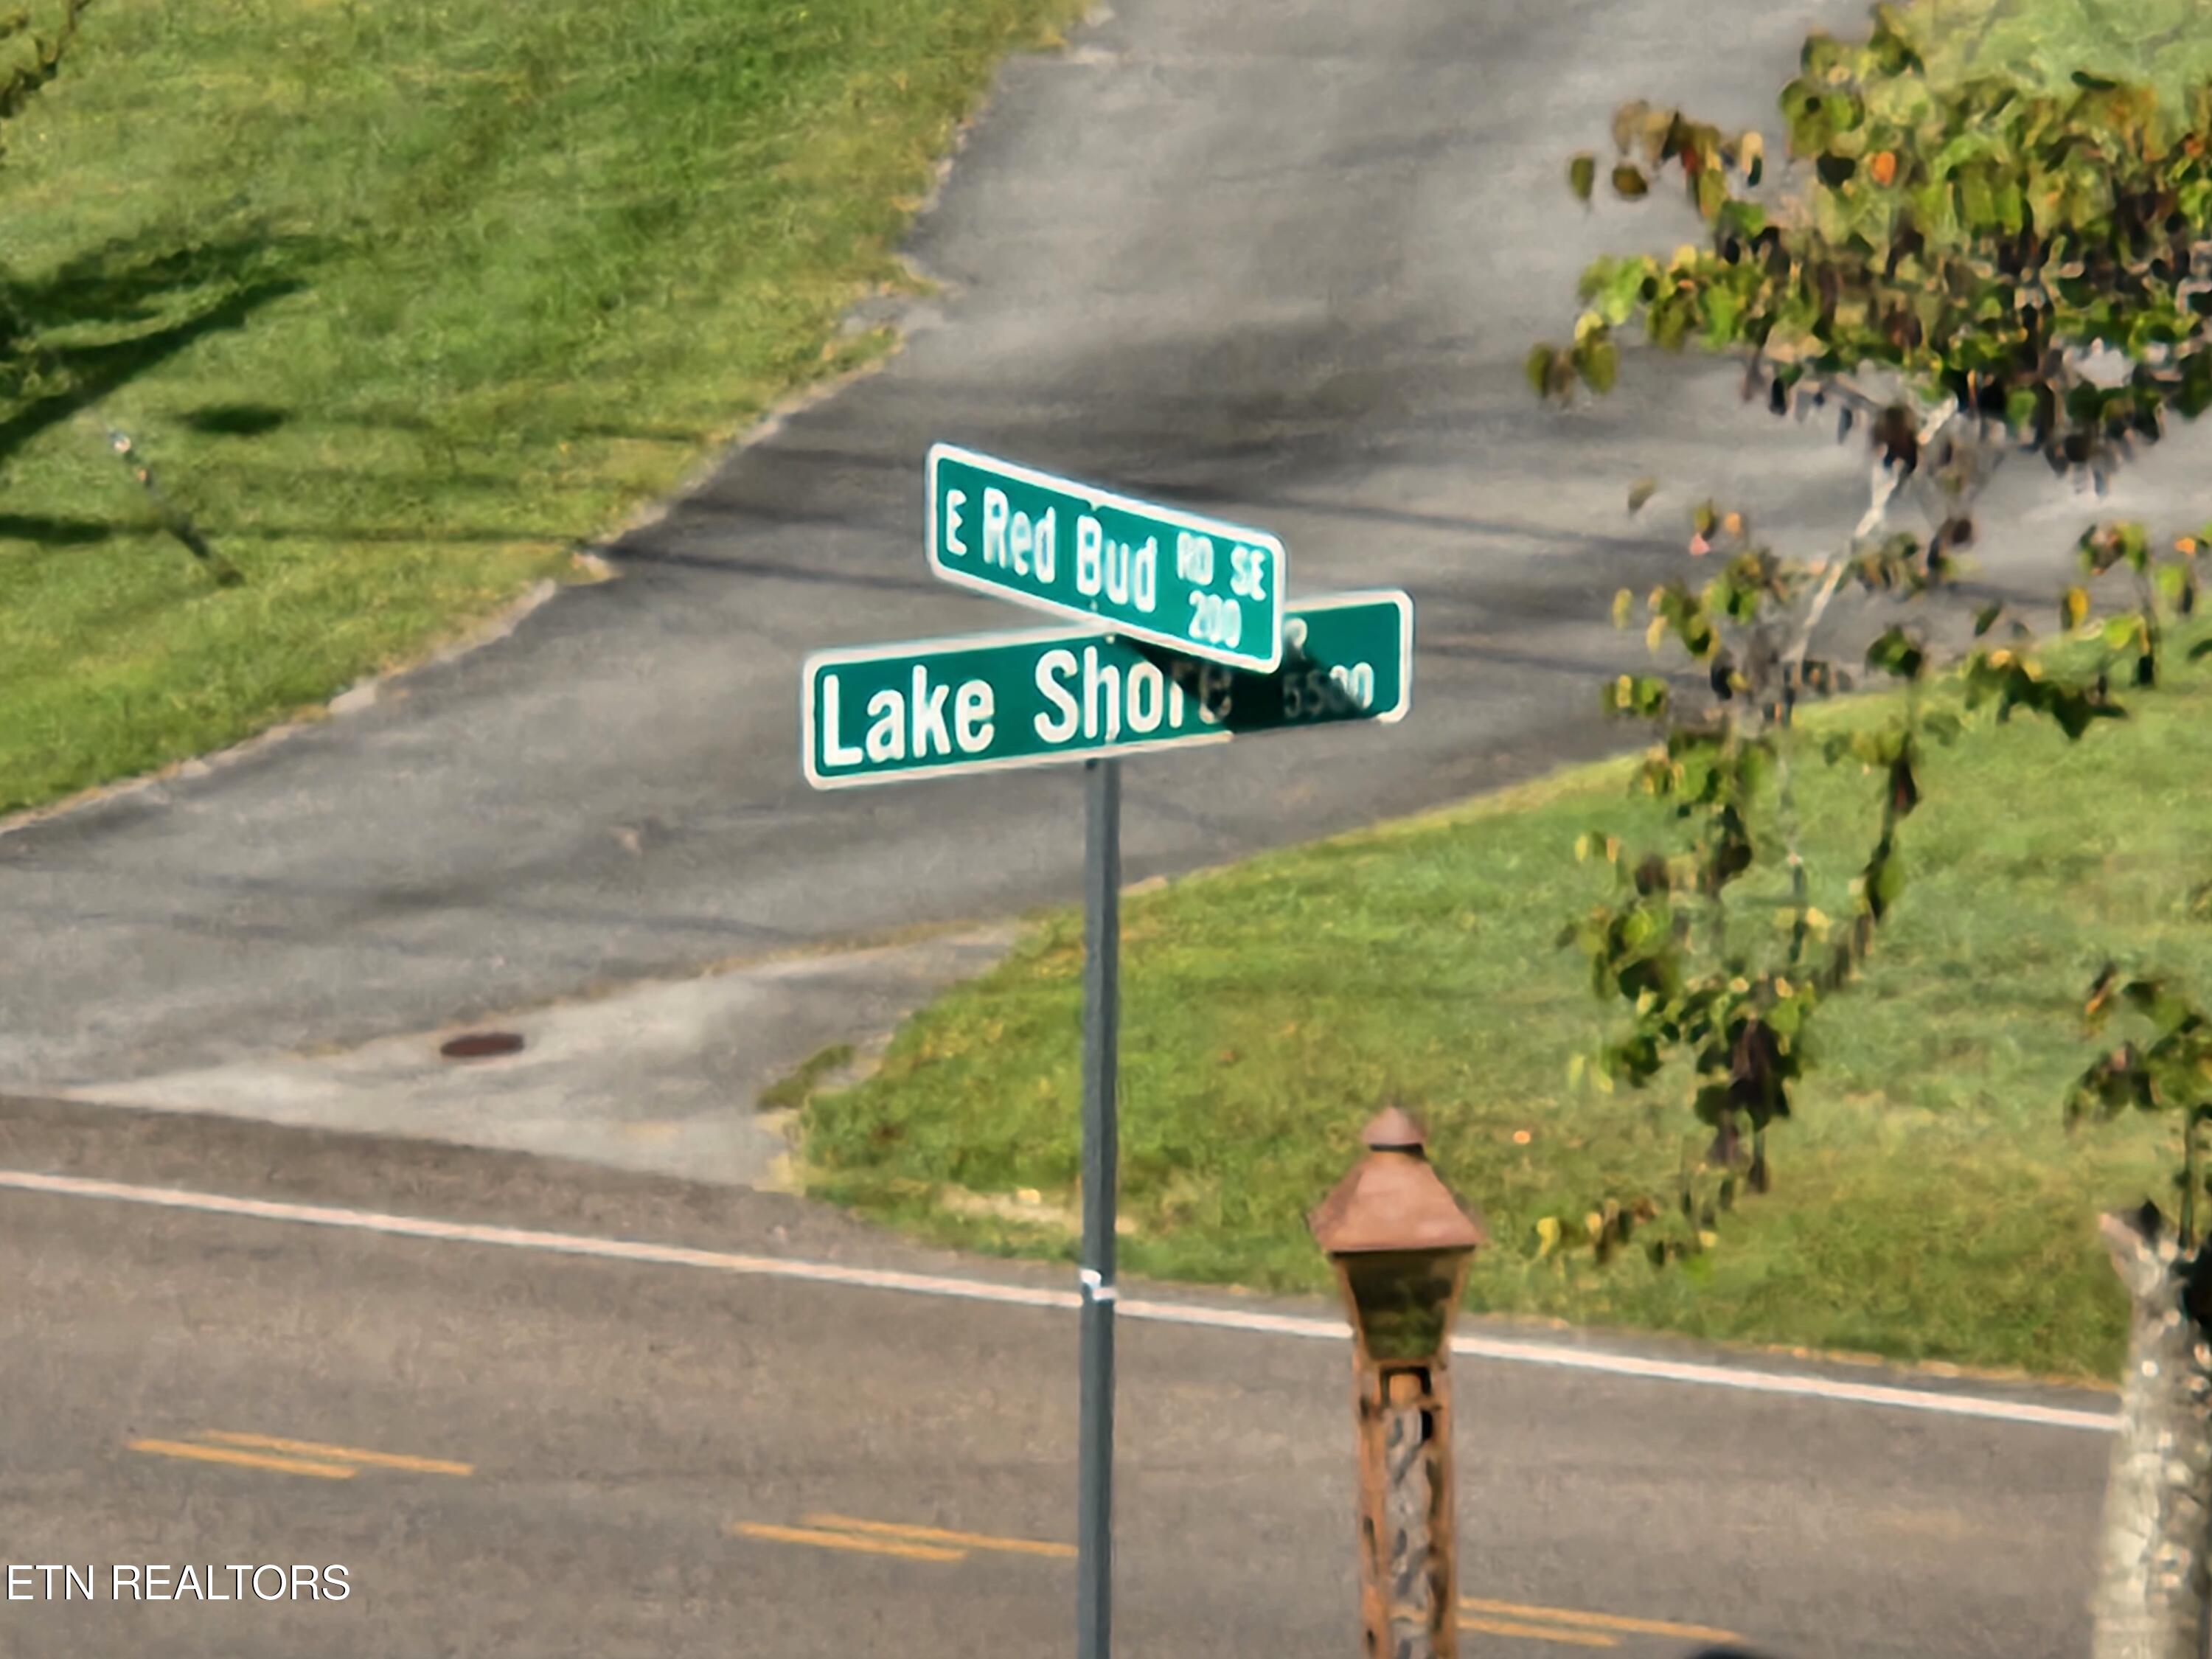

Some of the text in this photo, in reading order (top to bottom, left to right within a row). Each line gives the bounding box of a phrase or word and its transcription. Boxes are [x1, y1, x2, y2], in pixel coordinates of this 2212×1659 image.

[946, 486, 1267, 613] E Red Bud RD SE
[1188, 590, 1242, 649] 200
[822, 645, 1232, 768] Lake Shore
